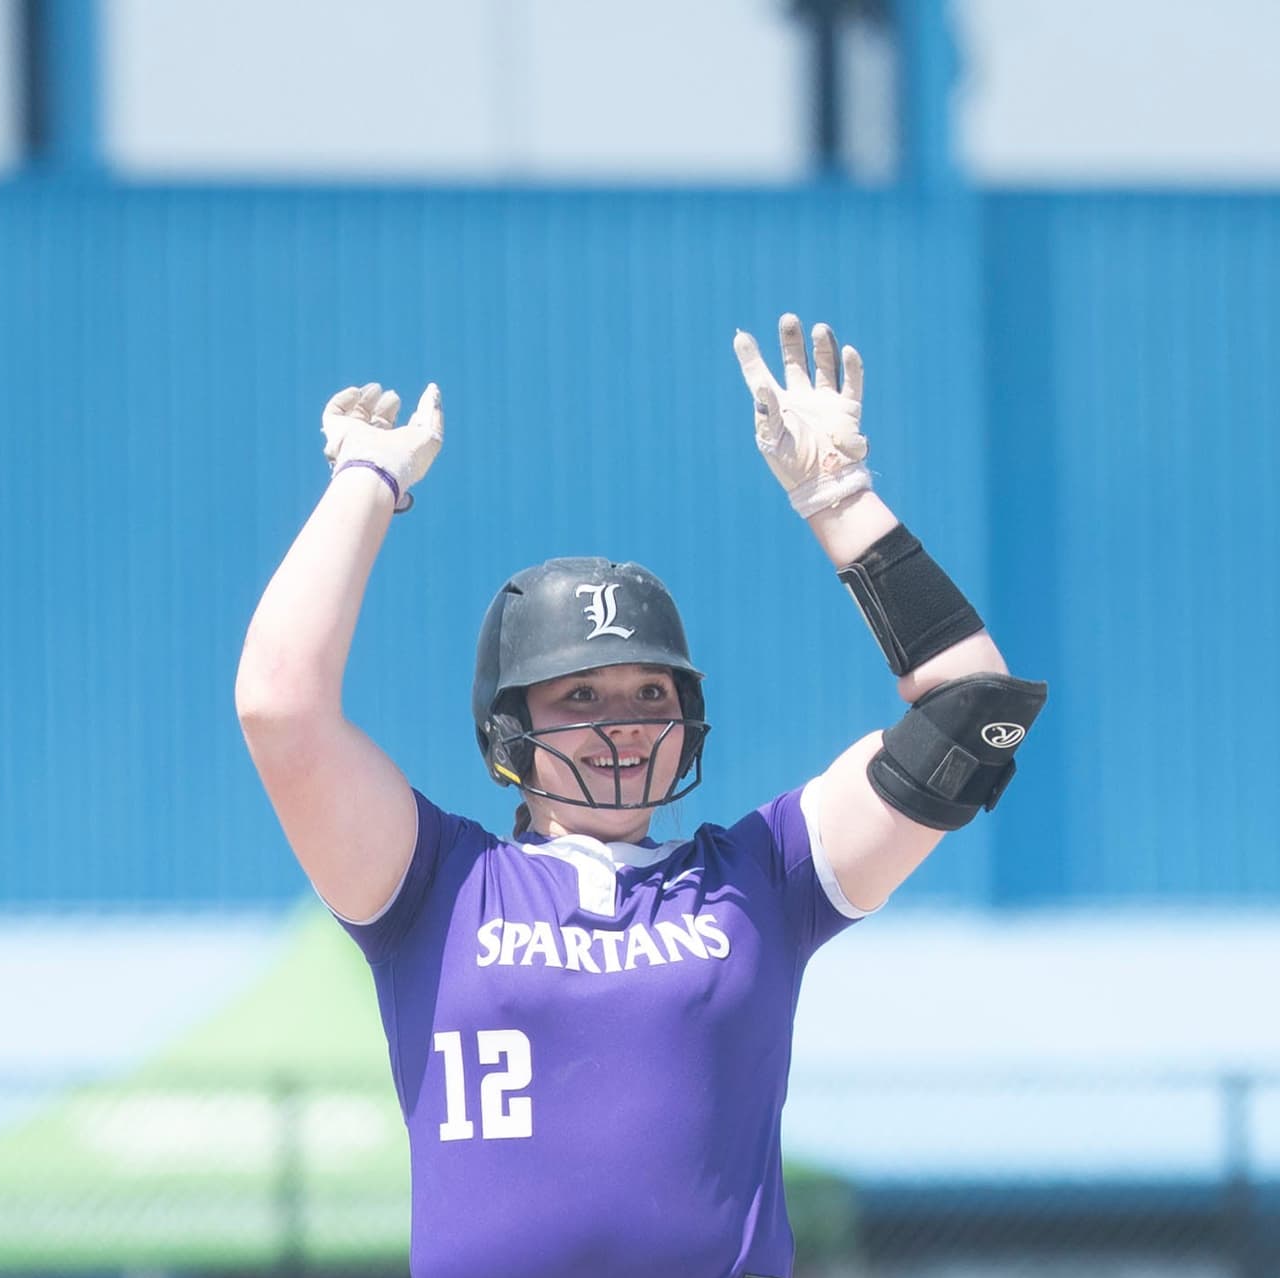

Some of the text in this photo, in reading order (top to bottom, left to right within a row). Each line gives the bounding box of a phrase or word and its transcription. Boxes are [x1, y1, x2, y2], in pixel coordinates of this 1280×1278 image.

[575, 583, 635, 640] L
[476, 914, 730, 974] SPARTANS
[433, 1029, 534, 1142] 12
